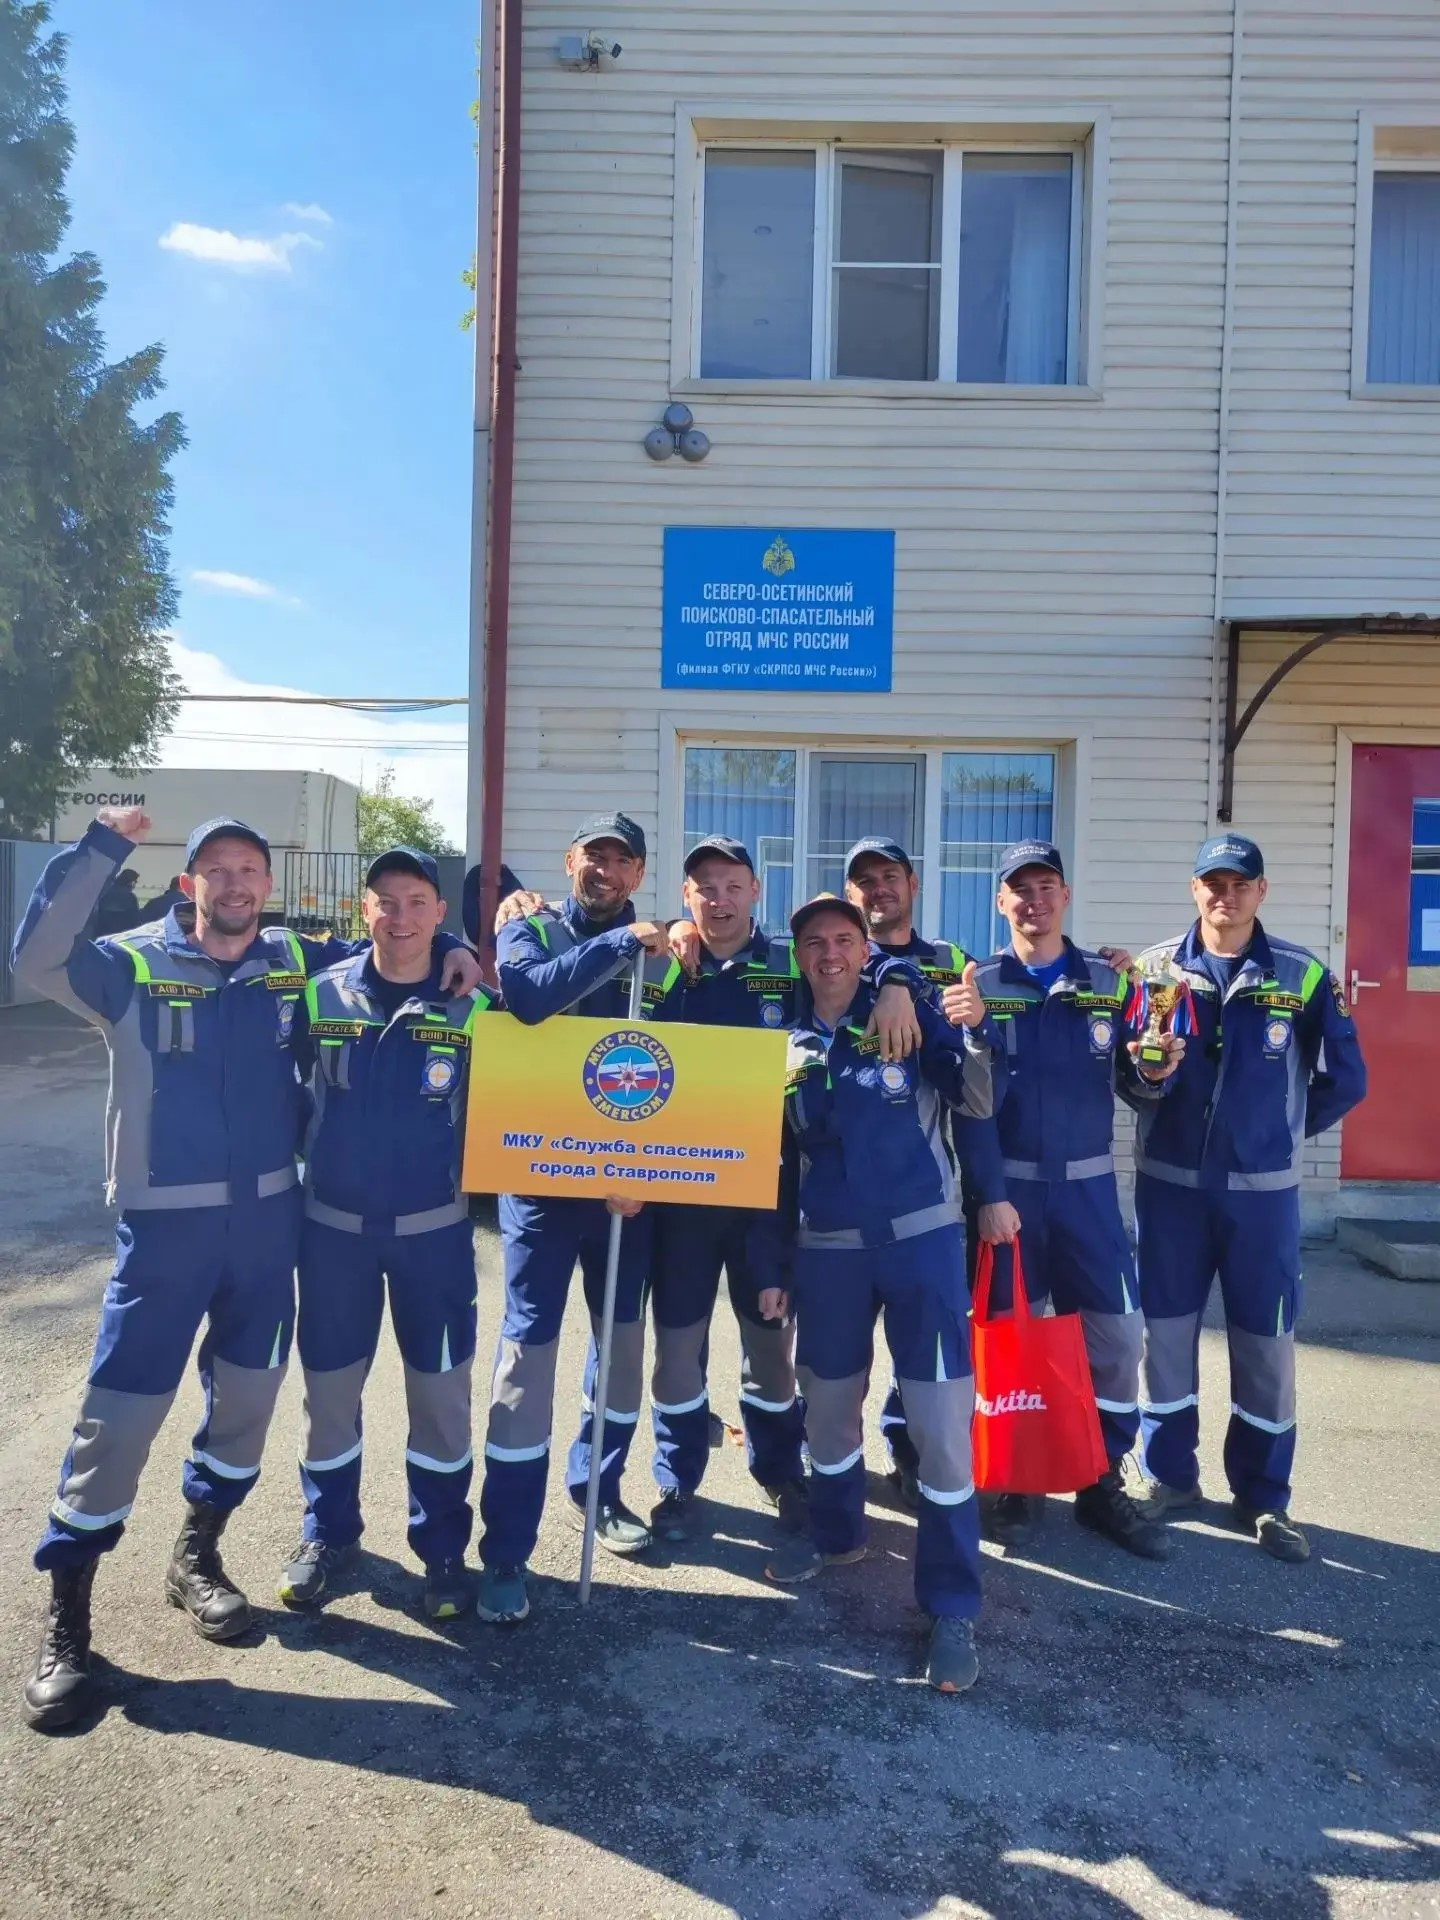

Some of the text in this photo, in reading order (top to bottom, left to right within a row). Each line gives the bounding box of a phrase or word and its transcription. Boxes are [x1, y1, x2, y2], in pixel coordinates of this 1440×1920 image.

[703, 582, 853, 602] СЕВЕРО-ОСЕТИНСКИЙ
[681, 606, 875, 626] ПОИСКОВО-СПАСАТЕЛЬНЫЙ
[705, 631, 850, 651] ОТРЯД МЧС РОССИИ
[677, 663, 877, 678] (филиал ФГКУ «СКРПСО МЧС России»)
[72, 792, 145, 806] РОССИИ
[268, 976, 306, 987] СПАСАТЕЛЬ
[312, 1023, 363, 1034] СПАСАТЕЛЬ
[588, 1032, 672, 1071] МЧС РОССИИ
[591, 1094, 664, 1121] EMERCOM
[503, 1133, 745, 1160] МКУ «Служба спасения»
[530, 1163, 716, 1182] города Ставрополя
